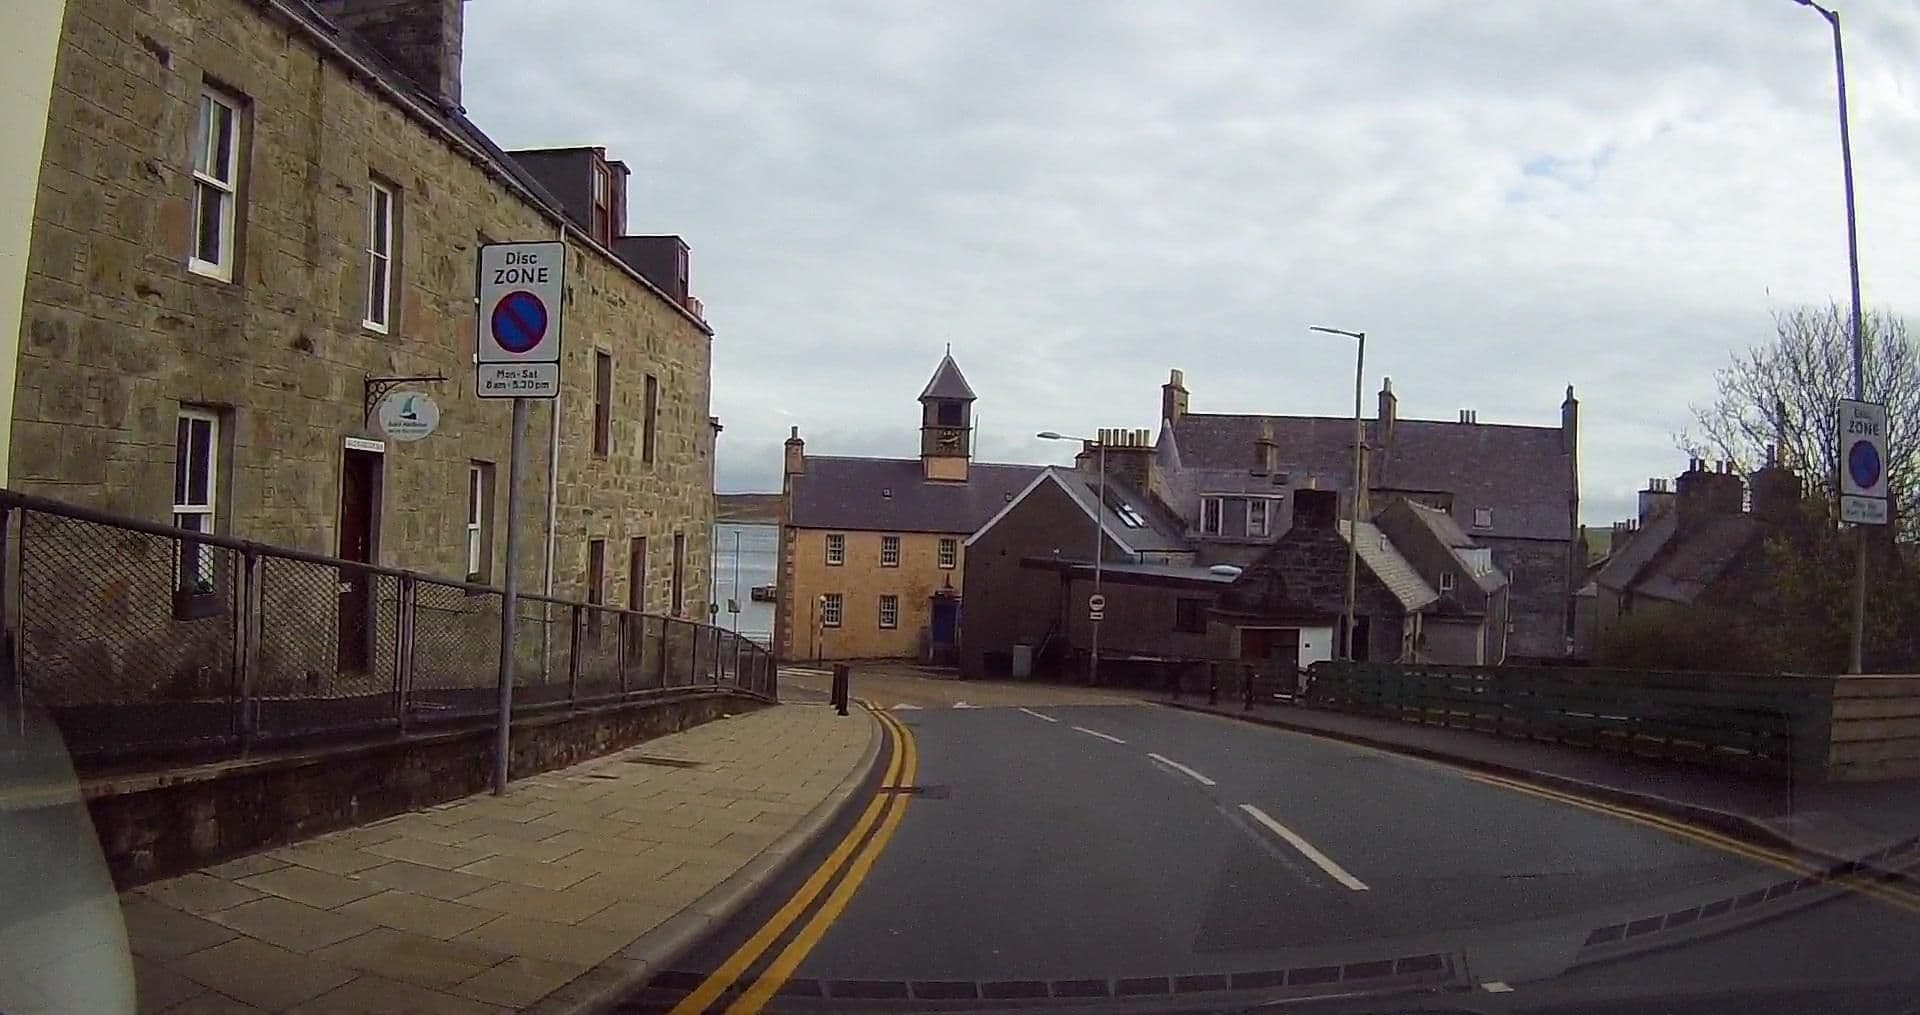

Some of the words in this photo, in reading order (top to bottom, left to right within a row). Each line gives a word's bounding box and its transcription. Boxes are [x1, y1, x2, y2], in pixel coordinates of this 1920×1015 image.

[505, 252, 538, 265] Disc
[494, 267, 549, 285] ZONE
[1848, 420, 1880, 436] ZONE
